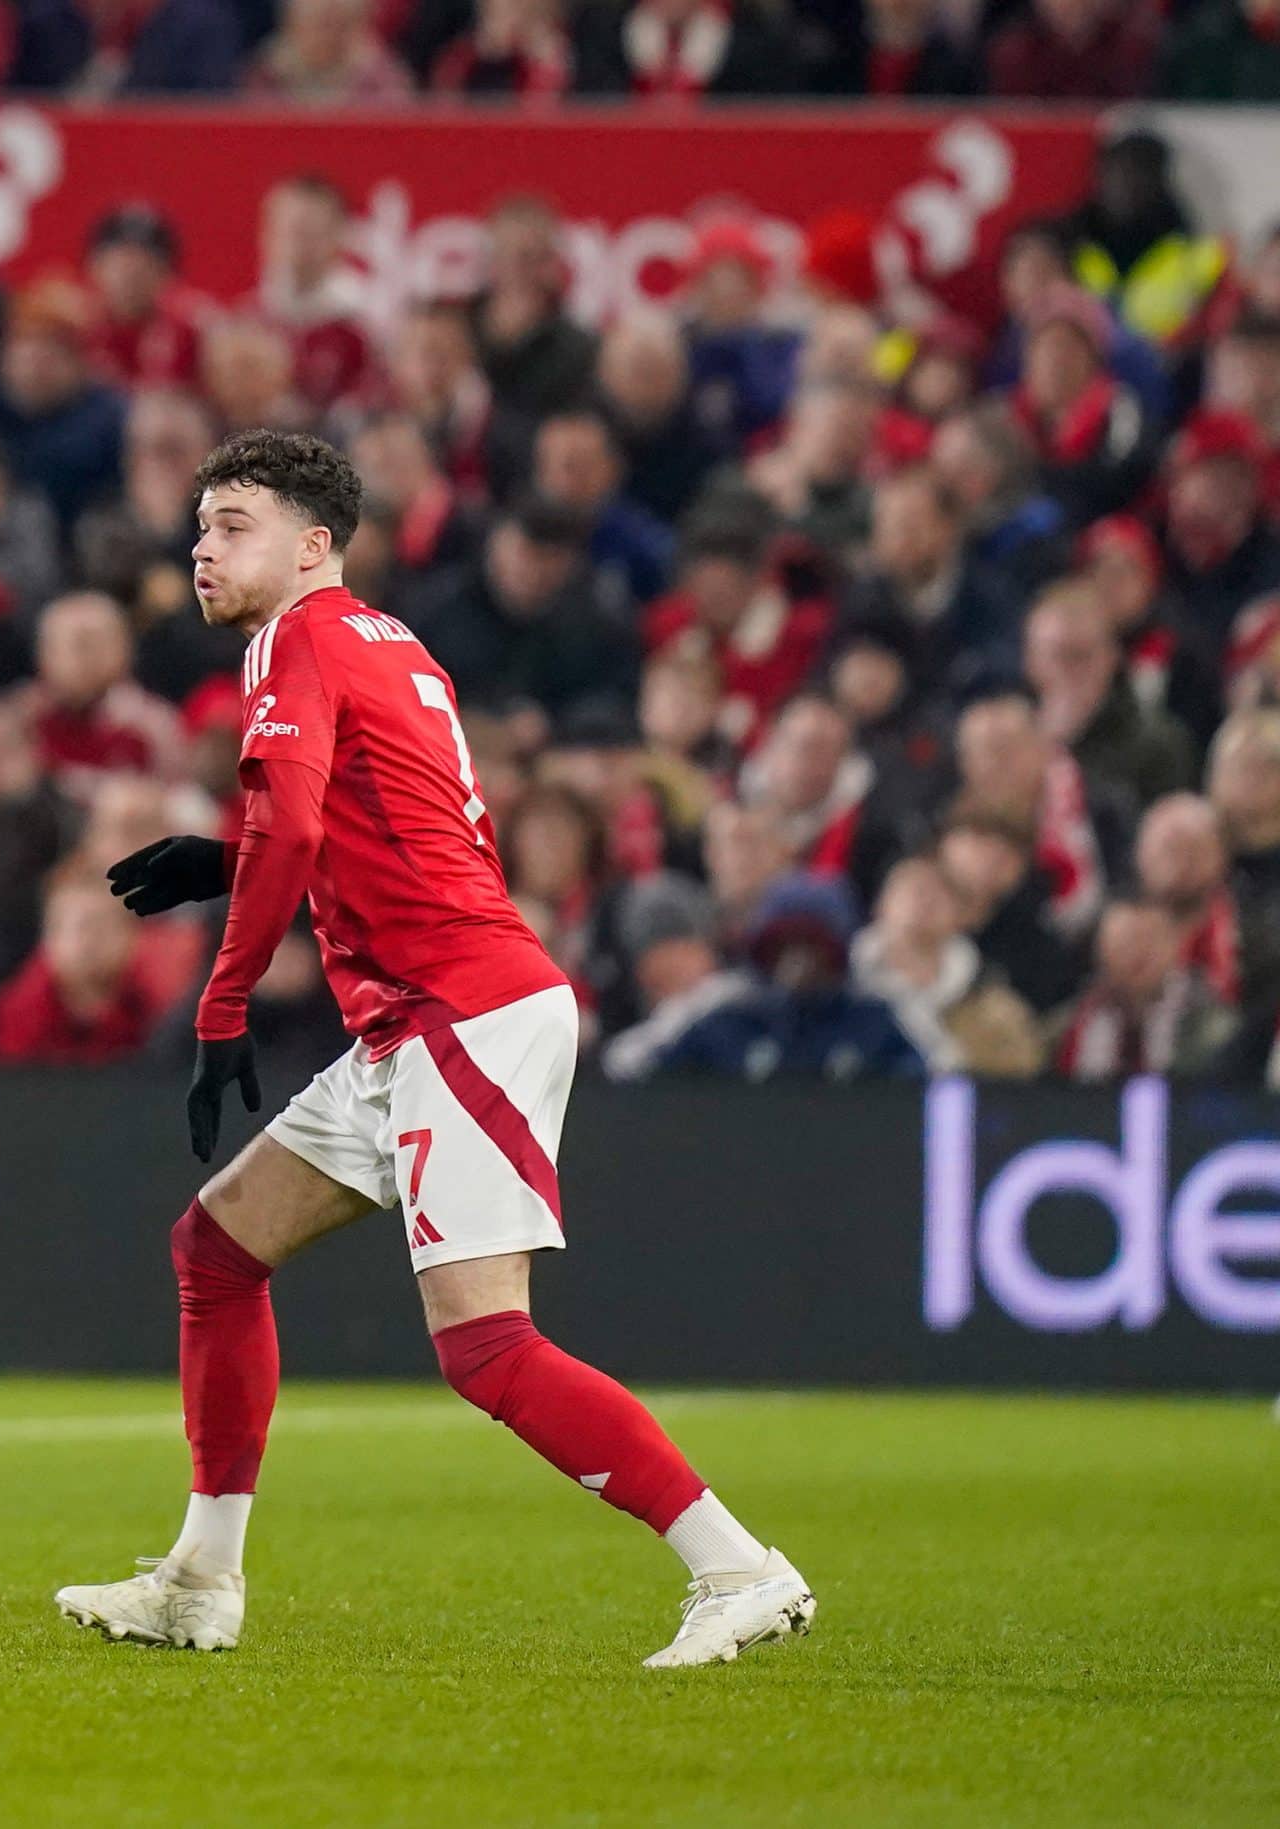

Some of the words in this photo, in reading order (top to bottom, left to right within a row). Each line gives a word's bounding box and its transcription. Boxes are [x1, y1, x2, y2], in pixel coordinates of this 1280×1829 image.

[245, 721, 300, 739] agen
[410, 672, 487, 846] 7
[398, 1128, 432, 1208] 7
